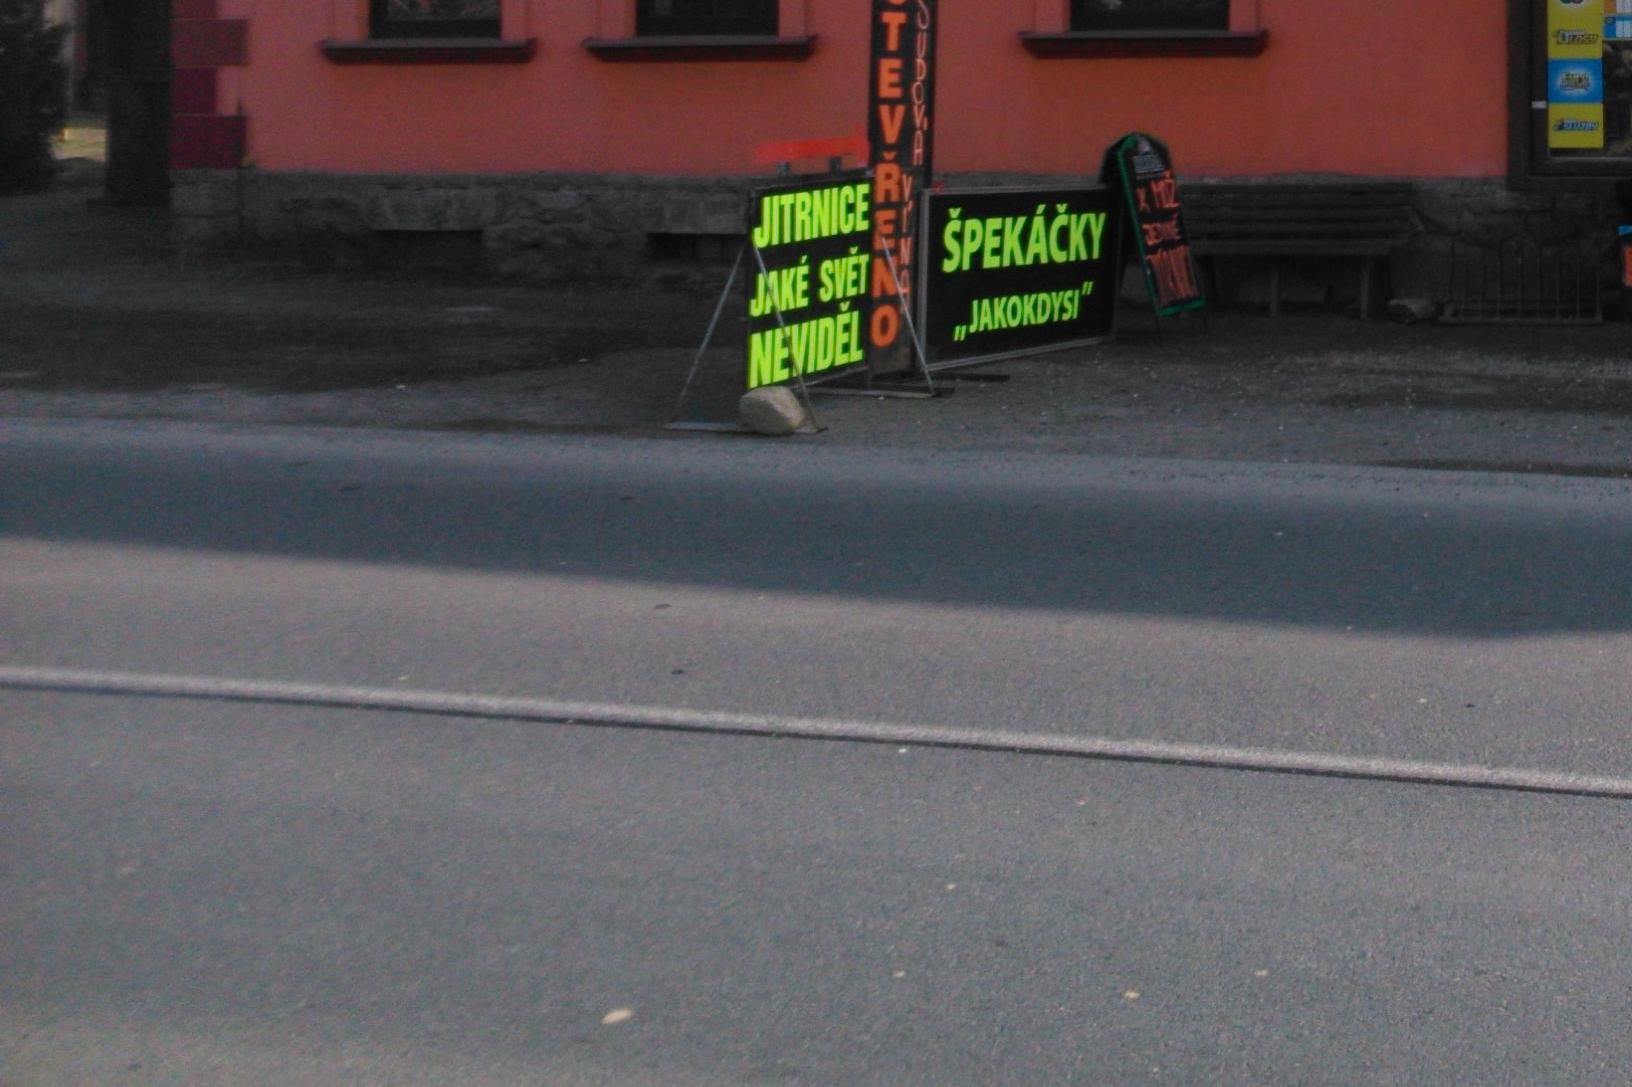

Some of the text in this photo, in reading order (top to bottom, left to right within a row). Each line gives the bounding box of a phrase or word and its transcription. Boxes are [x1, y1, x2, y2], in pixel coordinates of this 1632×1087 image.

[754, 183, 869, 249] JITRNICE
[942, 205, 1105, 274] ŠPEKÁČKY
[749, 247, 869, 317] JAKÉ SVĚT
[748, 298, 864, 388] NEVIDĚL
